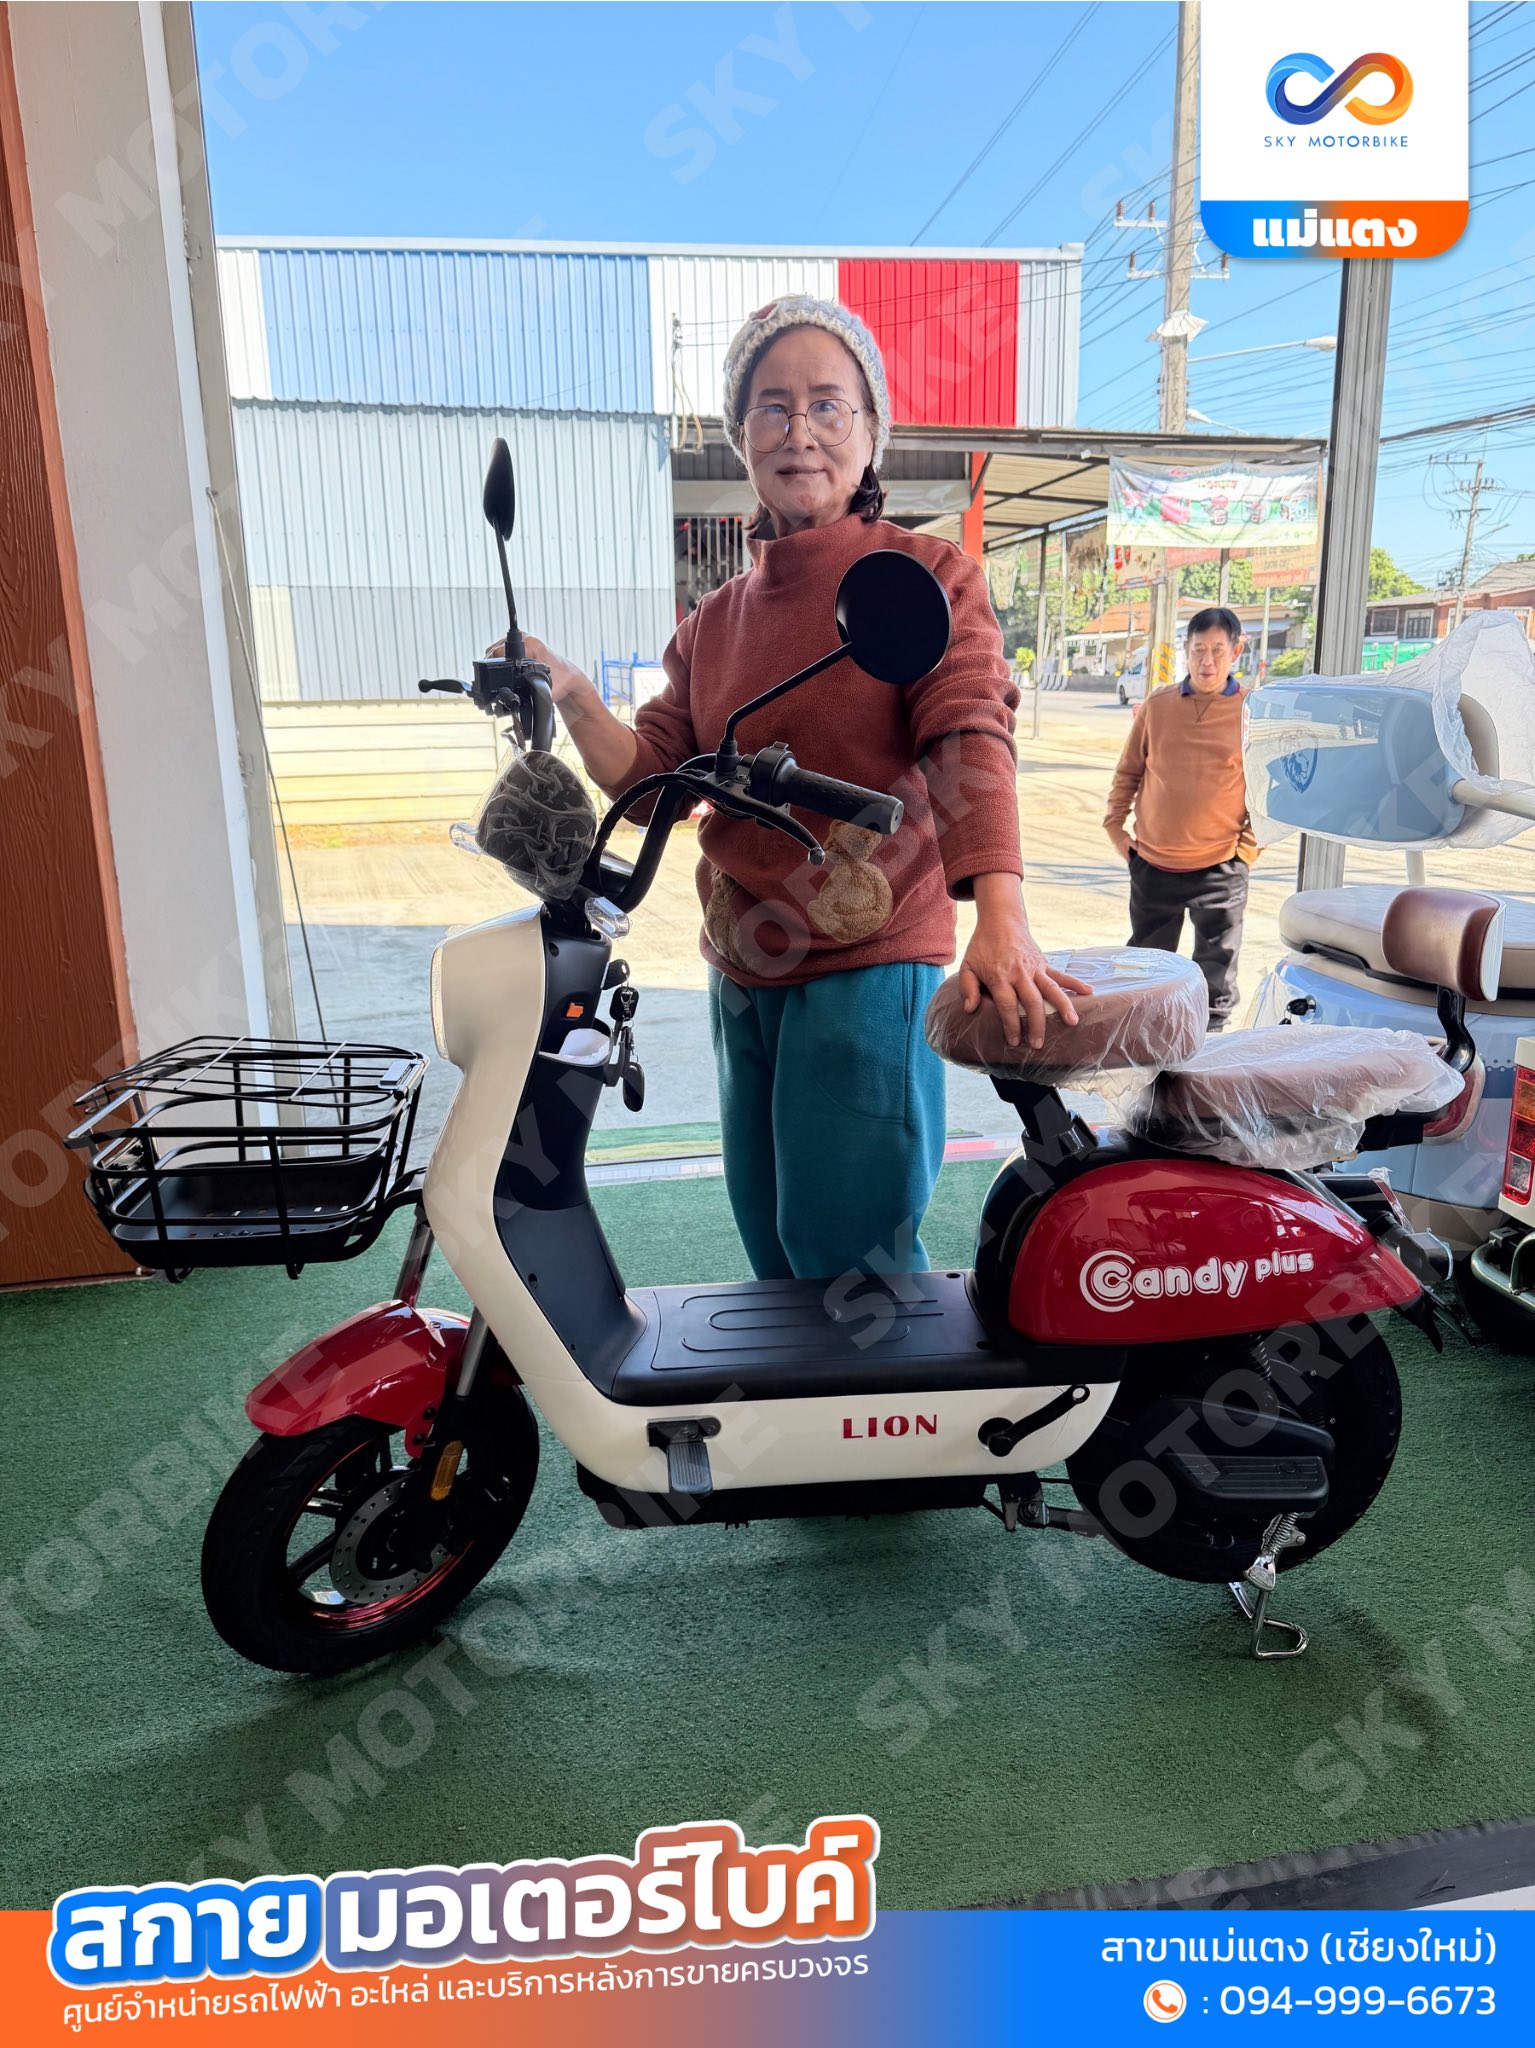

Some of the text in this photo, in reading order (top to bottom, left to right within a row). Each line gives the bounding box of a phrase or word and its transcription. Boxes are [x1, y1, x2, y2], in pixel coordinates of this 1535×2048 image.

[1079, 1248, 1315, 1313] Candy plus
[842, 1414, 938, 1440] LION
